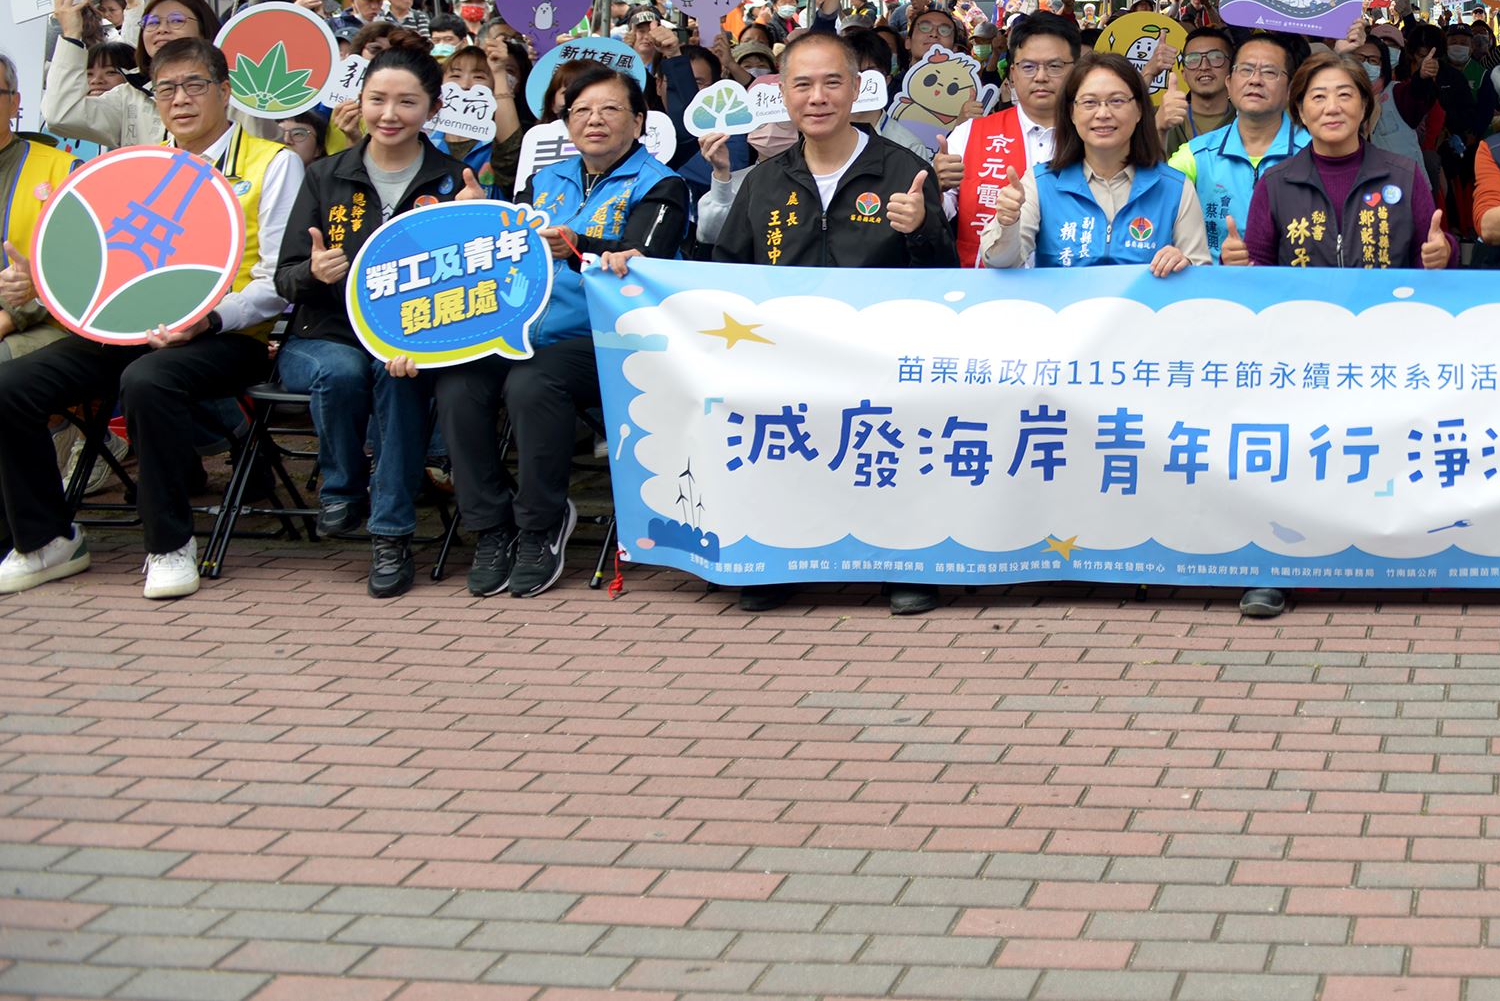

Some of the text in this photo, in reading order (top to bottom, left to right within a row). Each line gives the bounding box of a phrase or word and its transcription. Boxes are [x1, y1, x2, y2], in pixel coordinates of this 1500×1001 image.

[560, 45, 635, 70] 新竹有風
[430, 113, 489, 136] overnment
[970, 133, 1015, 236] 京元電子
[351, 192, 366, 232] 總幹事
[786, 192, 799, 226] 處長
[1311, 210, 1327, 241] 秘書
[766, 209, 784, 264] 王浩中
[1078, 216, 1095, 259] 副縣長
[1377, 206, 1391, 268] 苗栗縣議
[365, 229, 530, 301] 勞工及青年
[400, 279, 499, 337] 發展處
[1073, 559, 1166, 573] 新竹市青年發展中心
[1176, 564, 1259, 576] 新竹縣政府教育局
[1270, 566, 1375, 578] 桃園市政府青年事務局
[1386, 568, 1437, 578] 竹南鎮公所
